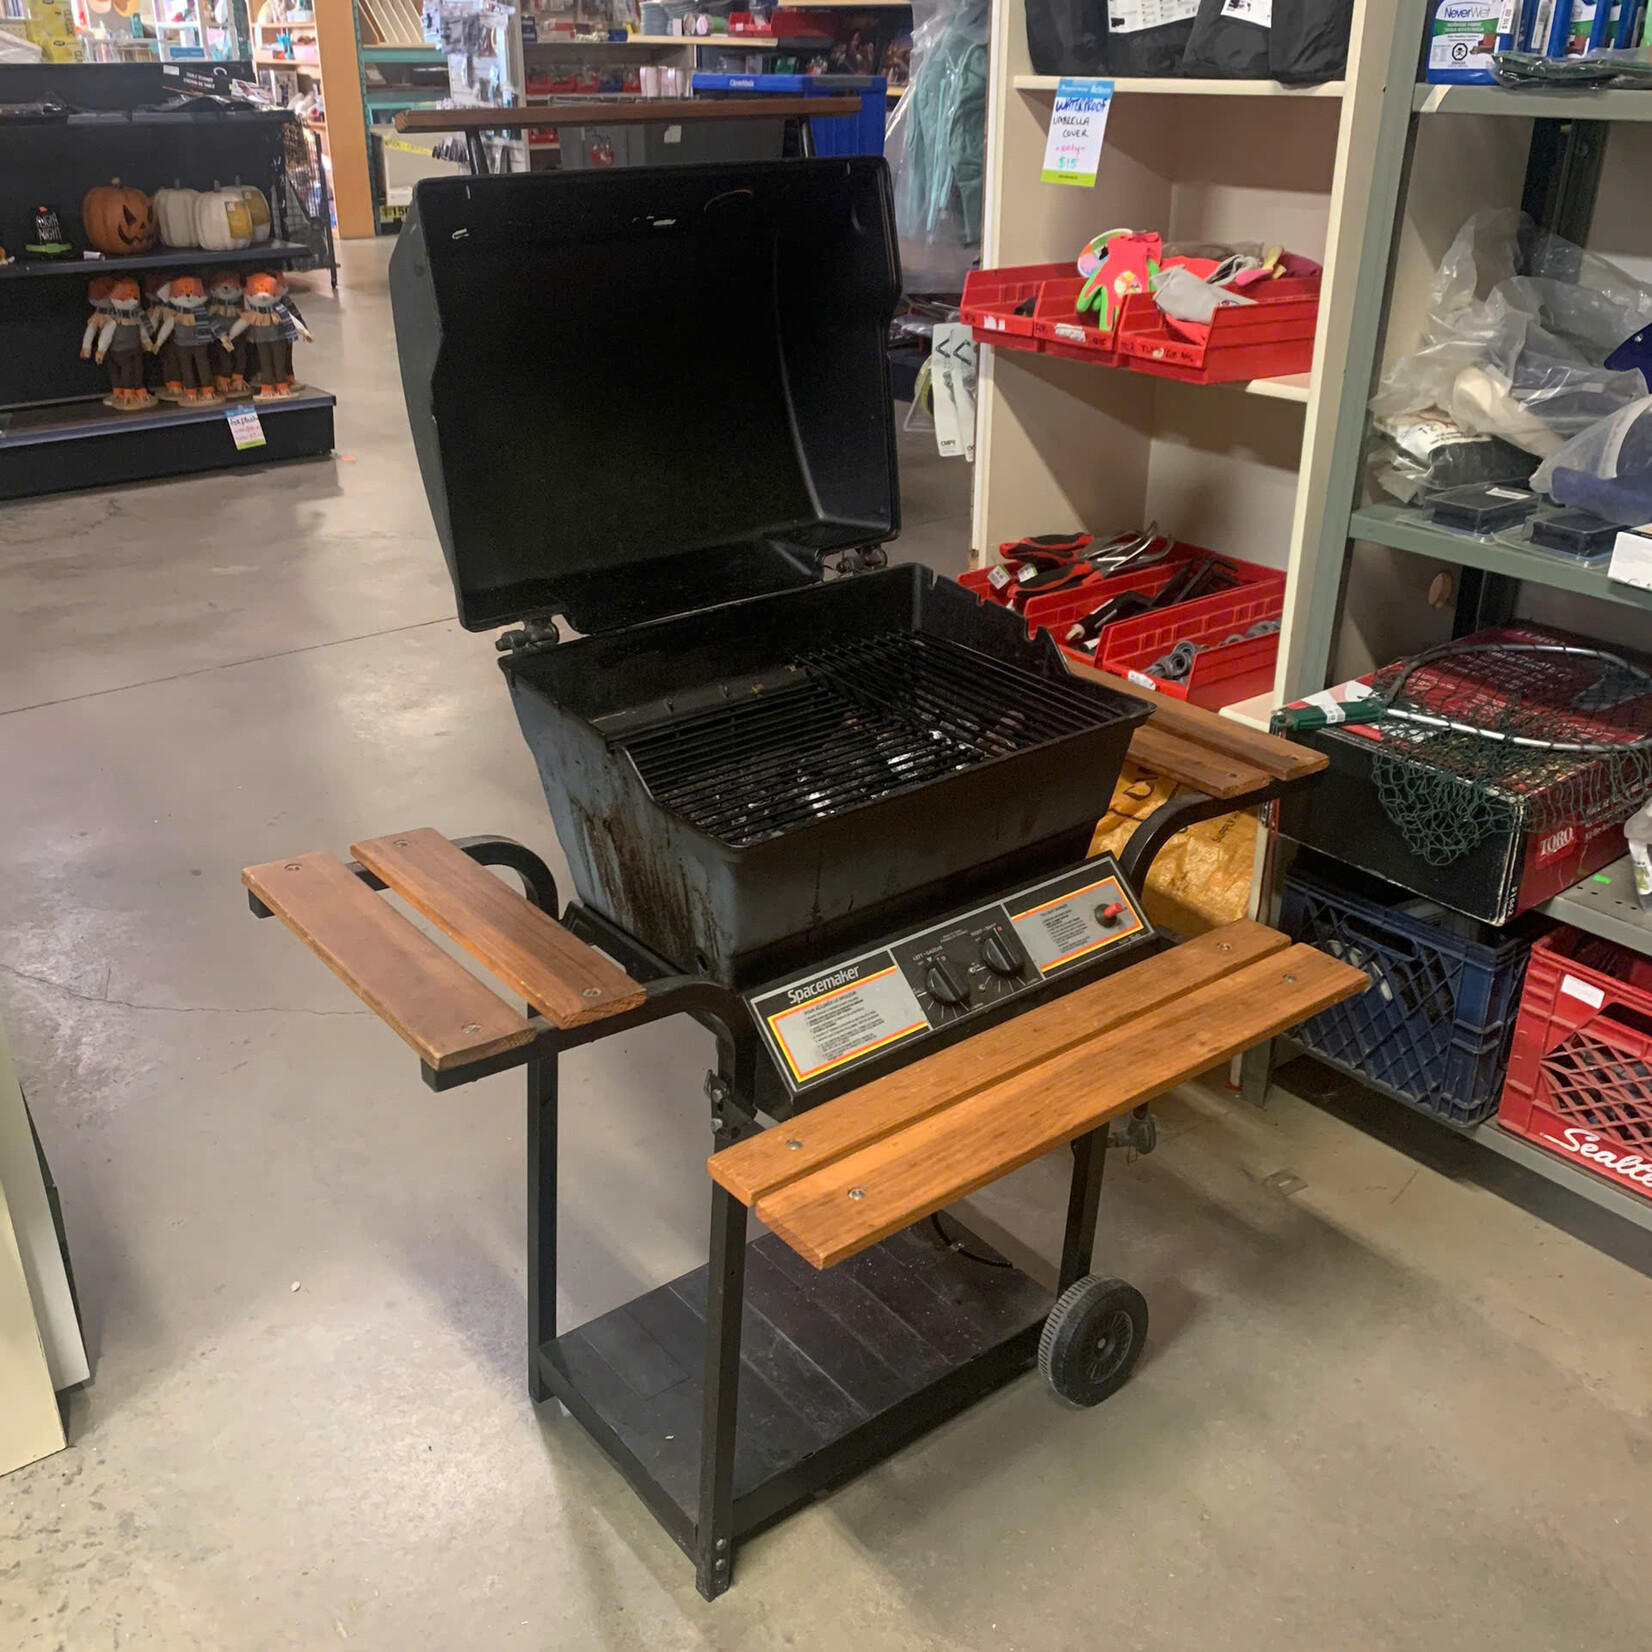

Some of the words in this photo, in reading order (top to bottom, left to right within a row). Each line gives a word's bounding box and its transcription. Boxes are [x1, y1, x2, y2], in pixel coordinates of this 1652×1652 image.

[1444, 7, 1490, 18] NeverWet
[1055, 97, 1108, 113] WATERPROOF
[1053, 115, 1090, 126] UMBRELLA
[1062, 129, 1089, 138] COVER
[1540, 827, 1573, 855] TORO
[787, 965, 860, 1005] Spacemaker
